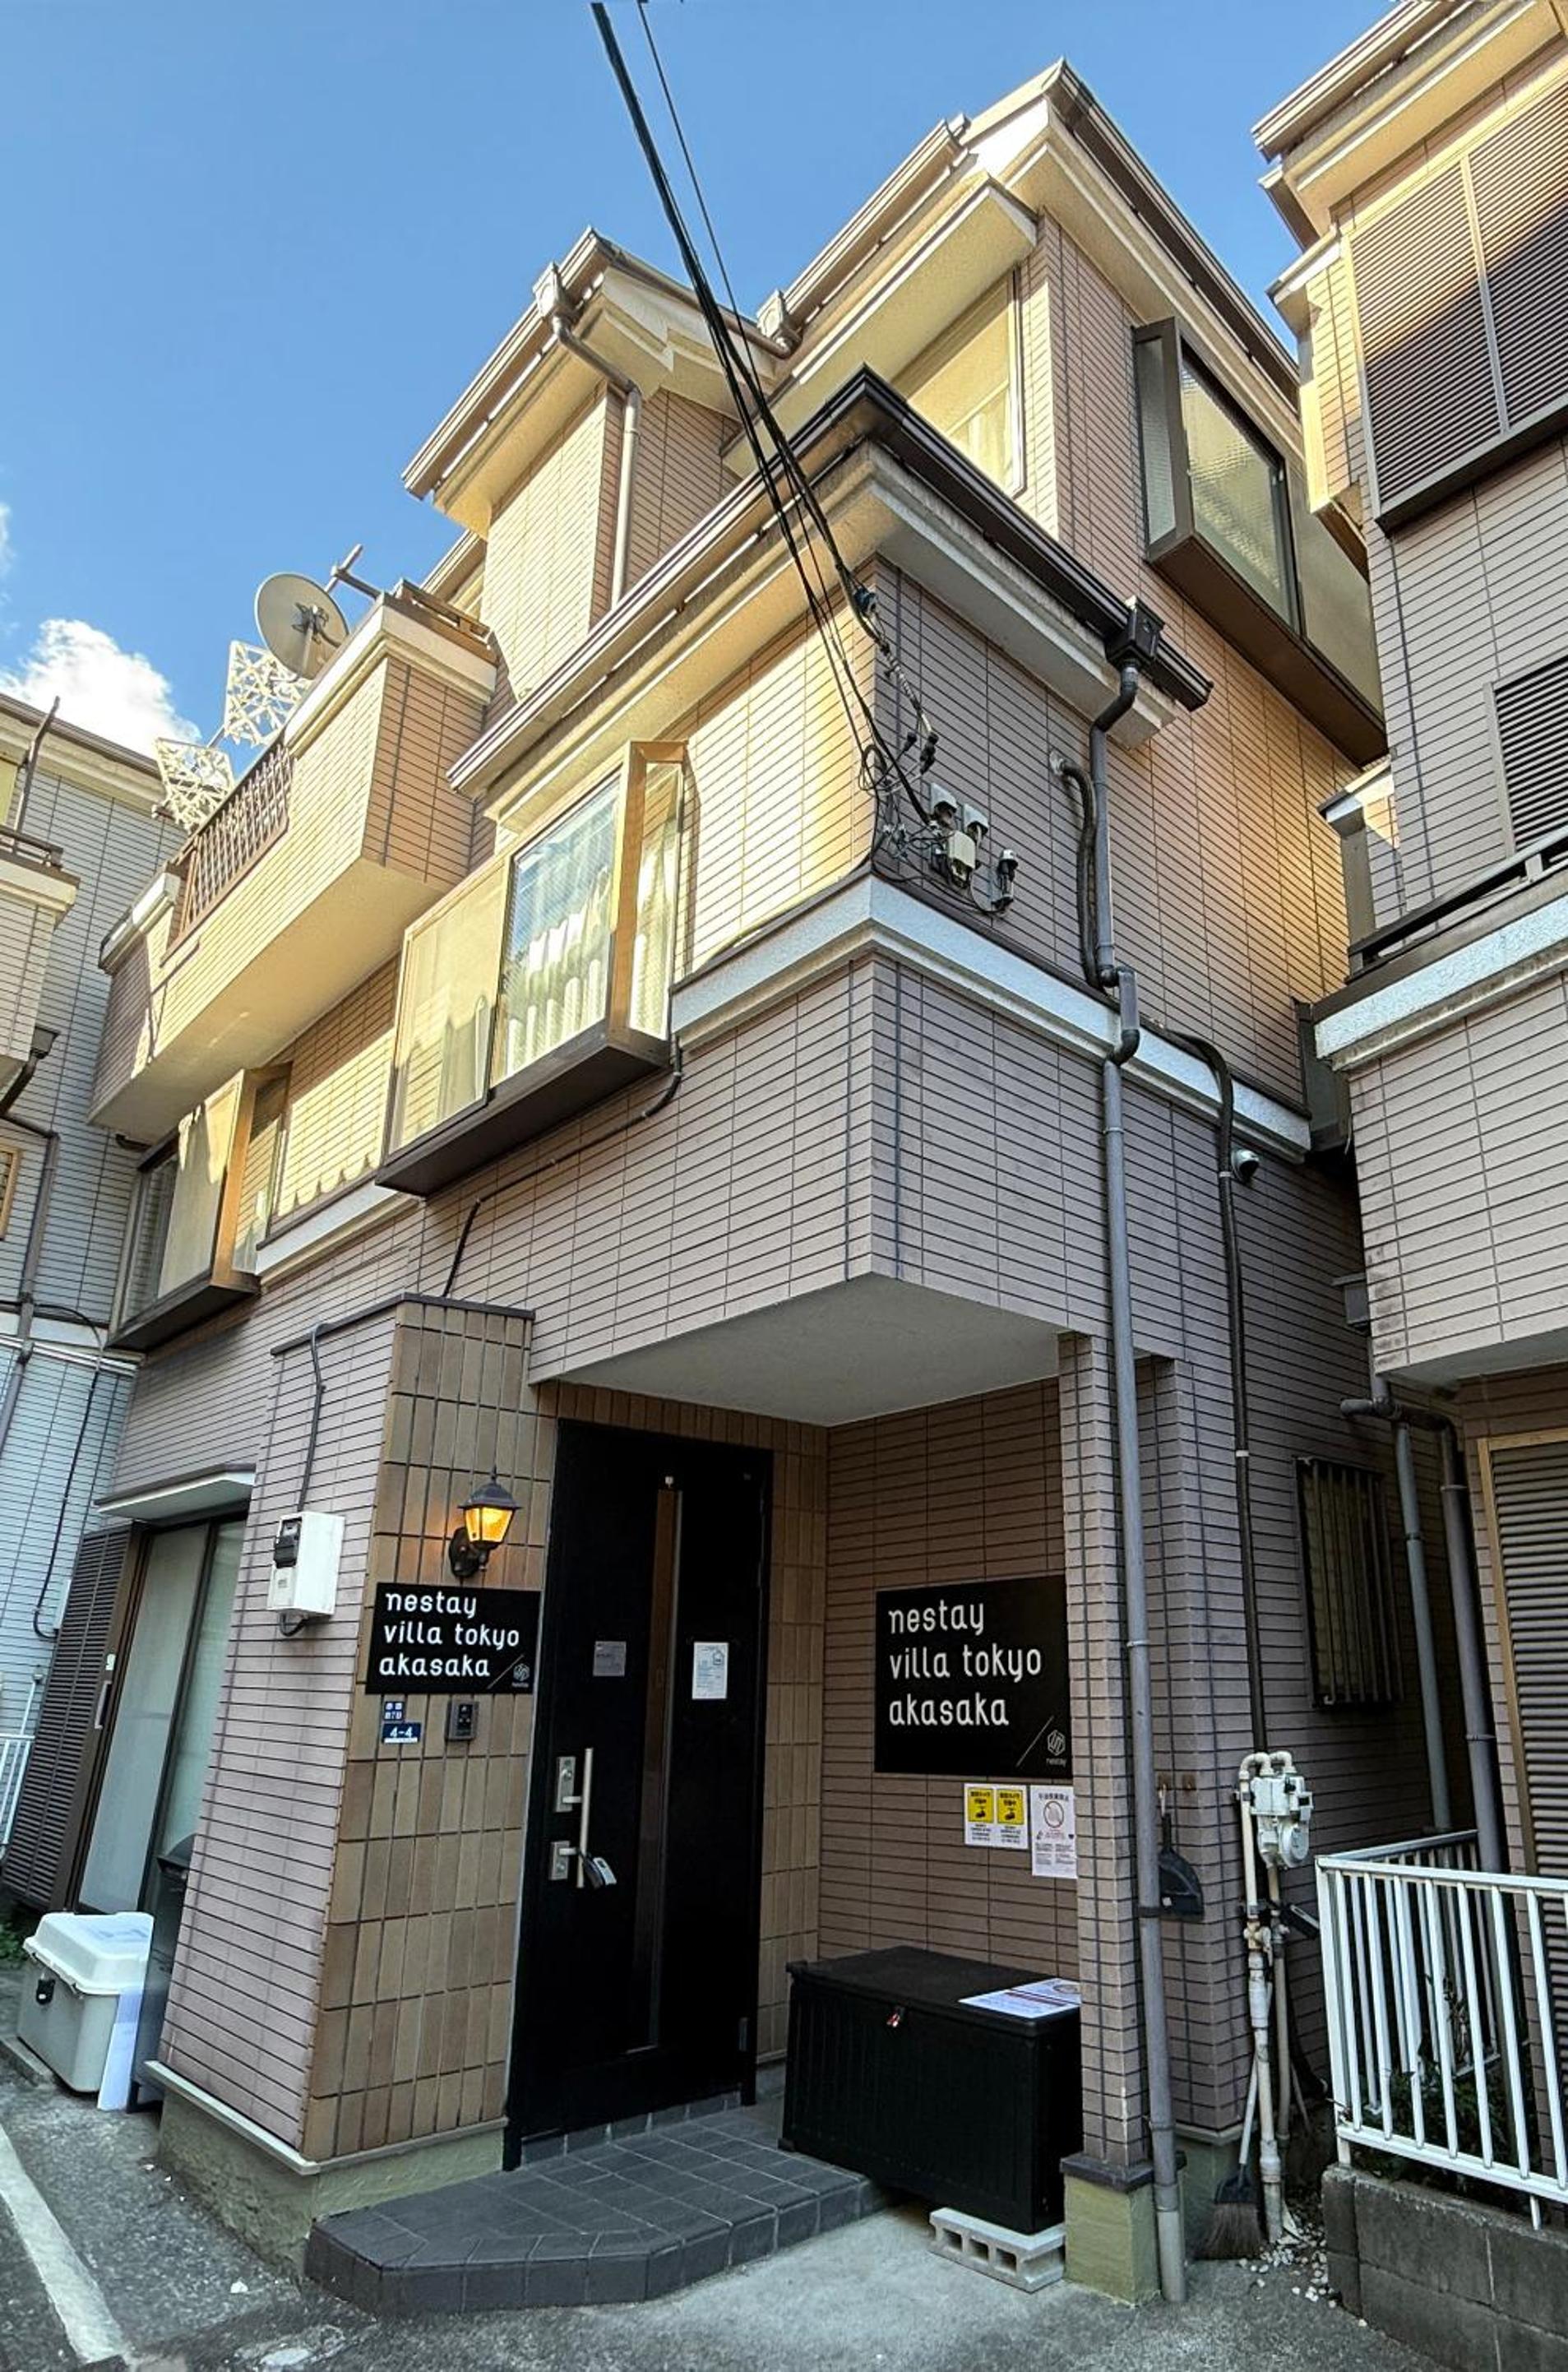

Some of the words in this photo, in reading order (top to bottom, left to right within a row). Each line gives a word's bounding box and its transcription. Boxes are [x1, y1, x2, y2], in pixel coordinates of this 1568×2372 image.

[385, 1591, 477, 1619] nestay
[888, 1599, 984, 1636] nestay
[384, 1620, 443, 1644] villa
[455, 1623, 520, 1651] tokyo
[379, 1652, 490, 1677] akasaka
[889, 1647, 951, 1679] villa
[962, 1642, 1042, 1683] tokyo
[889, 1692, 1010, 1726] akasaka
[390, 1726, 413, 1738] 4-4
